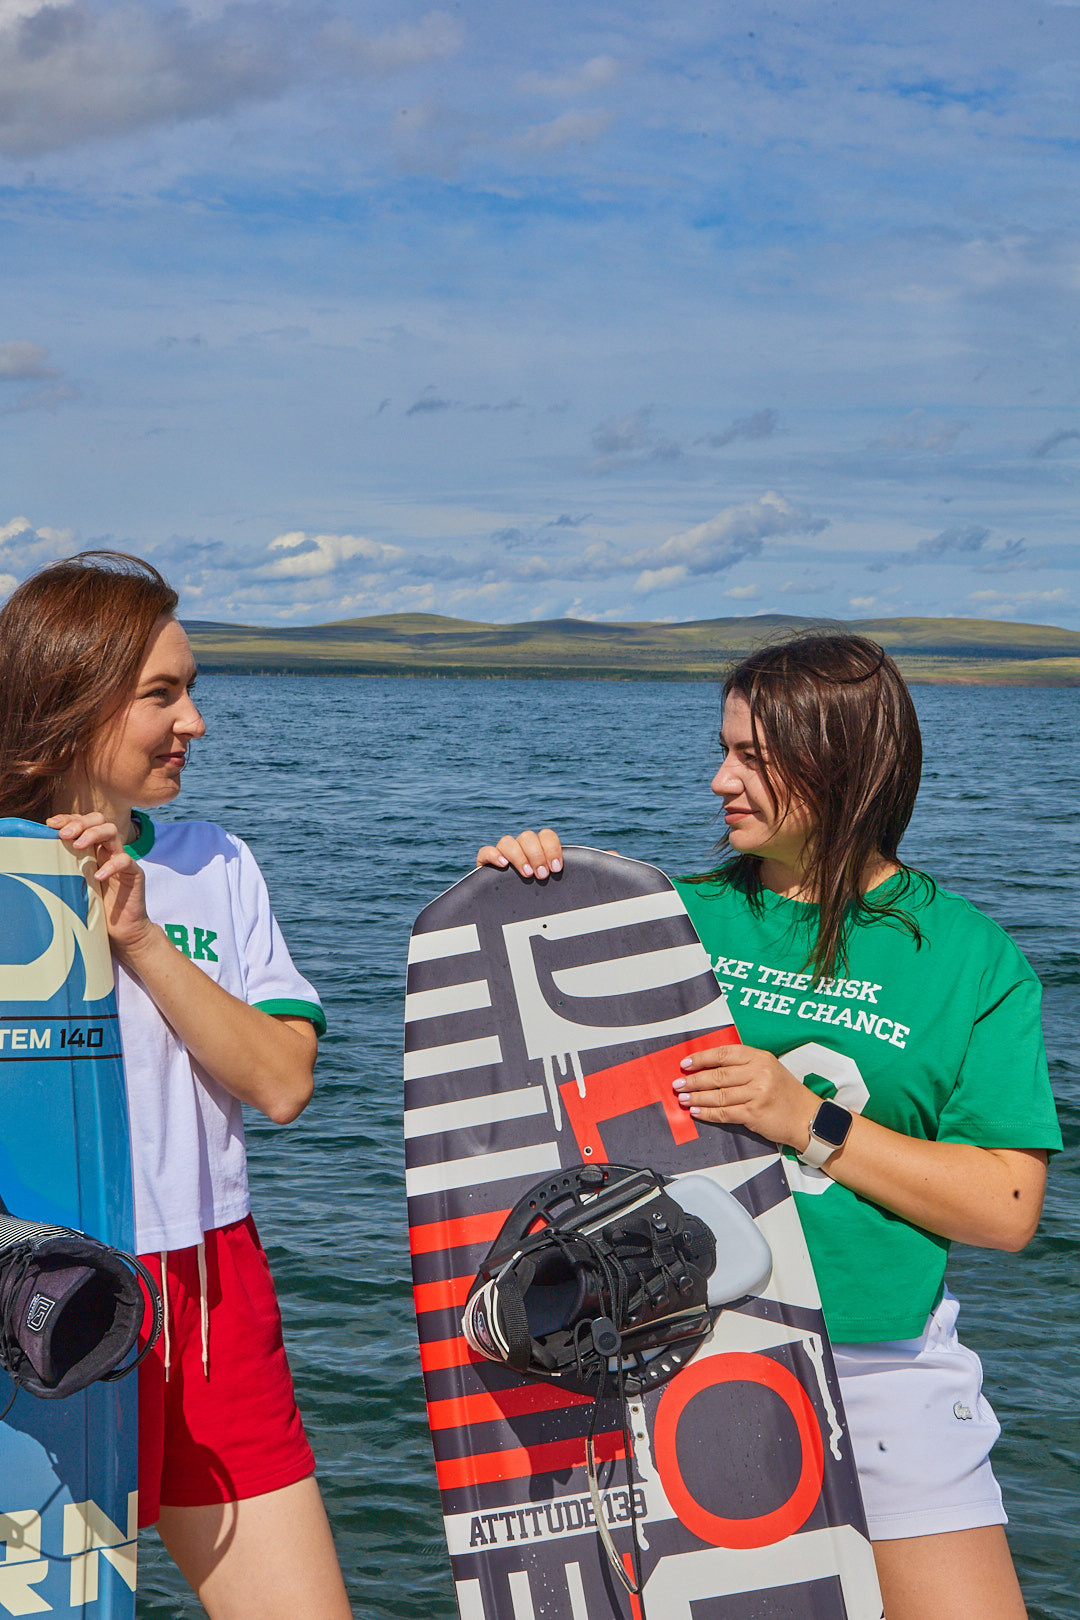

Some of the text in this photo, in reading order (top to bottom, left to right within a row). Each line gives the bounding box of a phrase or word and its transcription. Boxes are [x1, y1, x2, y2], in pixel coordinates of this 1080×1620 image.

[164, 923, 219, 963] RK
[757, 965, 813, 991] THE
[813, 976, 883, 1004] RISK
[59, 1027, 104, 1049] 140
[739, 986, 796, 1016] THE
[797, 1000, 911, 1050] CHANCE
[469, 1497, 598, 1548] ATTITUDE
